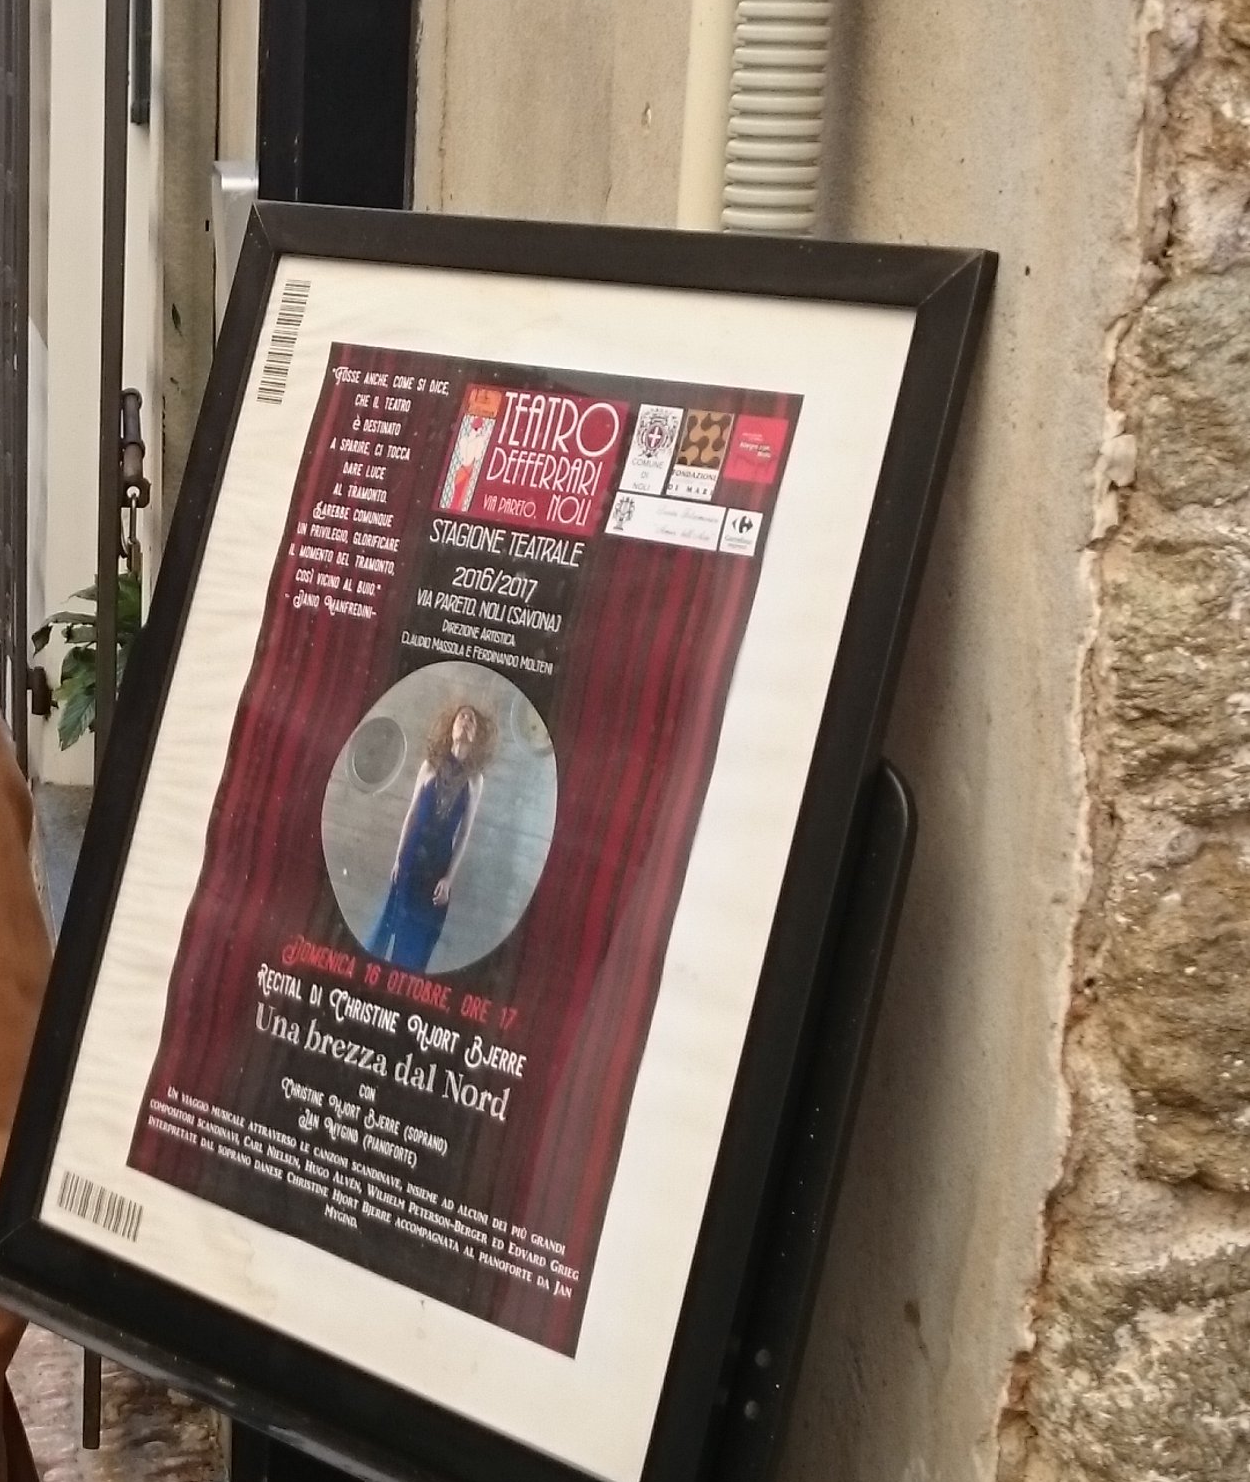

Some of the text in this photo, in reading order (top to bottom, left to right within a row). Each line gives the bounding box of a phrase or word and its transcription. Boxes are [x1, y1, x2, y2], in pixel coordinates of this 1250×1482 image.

[393, 374, 414, 391] COME
[417, 379, 427, 391] SI
[430, 381, 449, 396] DICE,
[355, 394, 411, 412] CHE IL TEATRO
[363, 419, 401, 435] DESTINATO
[498, 391, 619, 457] TEATRO
[330, 438, 336, 449] A
[374, 444, 384, 456] CI
[387, 444, 411, 461] TOCCA
[343, 463, 386, 480] DARE LUCE
[333, 483, 342, 495] AL
[353, 508, 393, 527] COMUNQUE
[483, 494, 496, 512] VIA
[547, 494, 591, 526] NOLI
[289, 544, 295, 556] IL
[299, 544, 334, 563] MOMENTO
[337, 551, 349, 566] DEL
[353, 532, 400, 552] GLORIFICARE
[429, 519, 585, 567] STAGIONE TEATRALE
[296, 568, 313, 583] COSÌ
[316, 574, 339, 588] VICINO
[343, 579, 352, 591] AL
[452, 567, 538, 603] 2016/2017
[417, 588, 431, 607] VIA
[479, 600, 506, 621] NOLI
[466, 646, 471, 657] E
[309, 984, 323, 1006] DI
[364, 963, 382, 985] 16
[460, 995, 492, 1023] ORE
[501, 1006, 518, 1031] 17
[255, 1001, 511, 1121] Una brezza dal Nord
[362, 1134, 417, 1169] (PIANOFORTE)
[403, 1125, 448, 1157] (SOPRANO)
[150, 1099, 195, 1126] COMPOSITORI
[491, 1237, 504, 1250] ED
[181, 1089, 209, 1112] VIAGGIO
[211, 1104, 245, 1128] MUSICALE
[248, 1121, 297, 1148] ATTRAVERSO
[300, 1141, 310, 1152] LE
[313, 1146, 349, 1169] CANZONI
[406, 1182, 438, 1204] INSIEME
[441, 1197, 454, 1211] AD
[457, 1205, 489, 1224] ALCUNI
[492, 1218, 507, 1232] DEI
[531, 1233, 566, 1256] GRANDI
[148, 1115, 197, 1144] INTERPRETATE
[201, 1138, 215, 1152] DAL
[218, 1144, 251, 1166] SOPRANO
[254, 1160, 283, 1180] DANESE
[395, 1217, 459, 1253] ACCOMPAGNATA
[463, 1246, 475, 1259] AL
[479, 1251, 532, 1282] PIANOFORTE
[537, 1276, 550, 1289] DA
